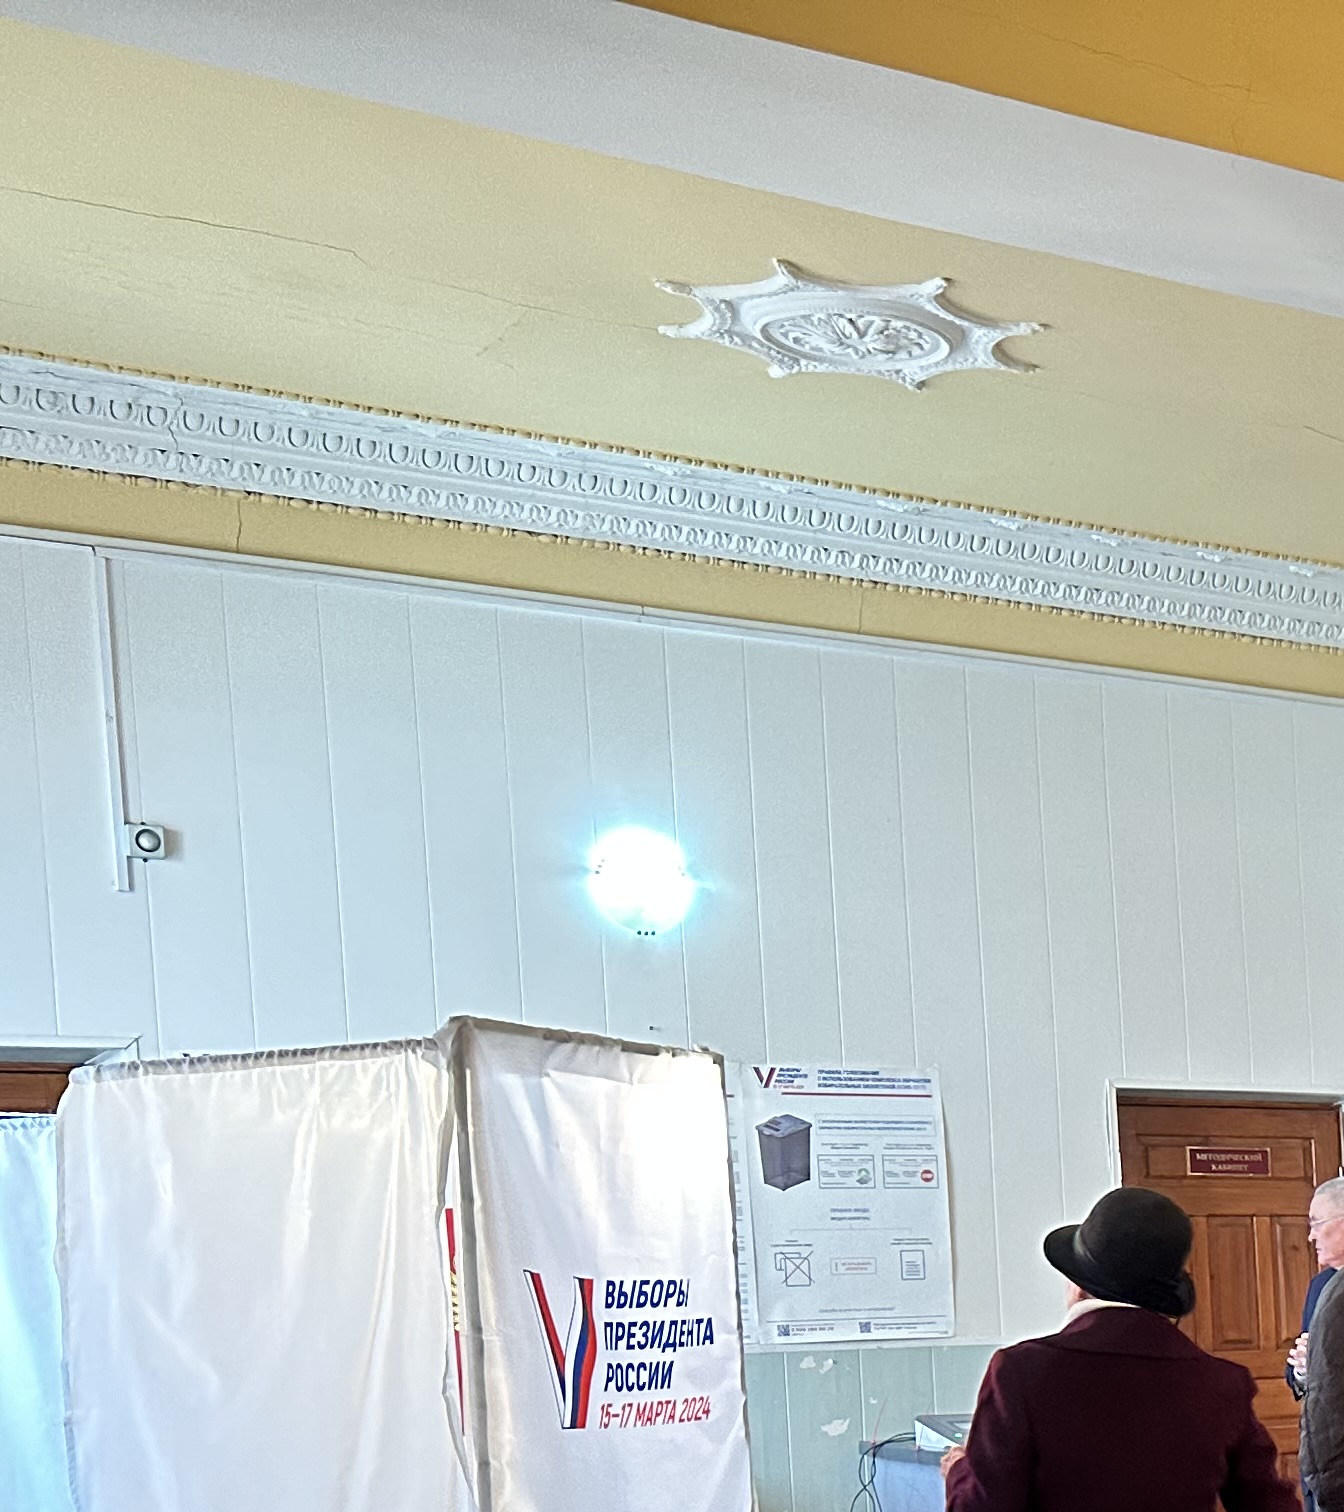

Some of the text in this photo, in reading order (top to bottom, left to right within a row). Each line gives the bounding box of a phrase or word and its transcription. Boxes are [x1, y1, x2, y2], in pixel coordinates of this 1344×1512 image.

[604, 1279, 690, 1309] ВЫБОРЫ
[604, 1317, 714, 1353] ПРЕЗИДЕНТА
[604, 1361, 674, 1392] РОССИИ
[634, 1399, 676, 1426] МАРТА
[679, 1396, 711, 1423] 2024
